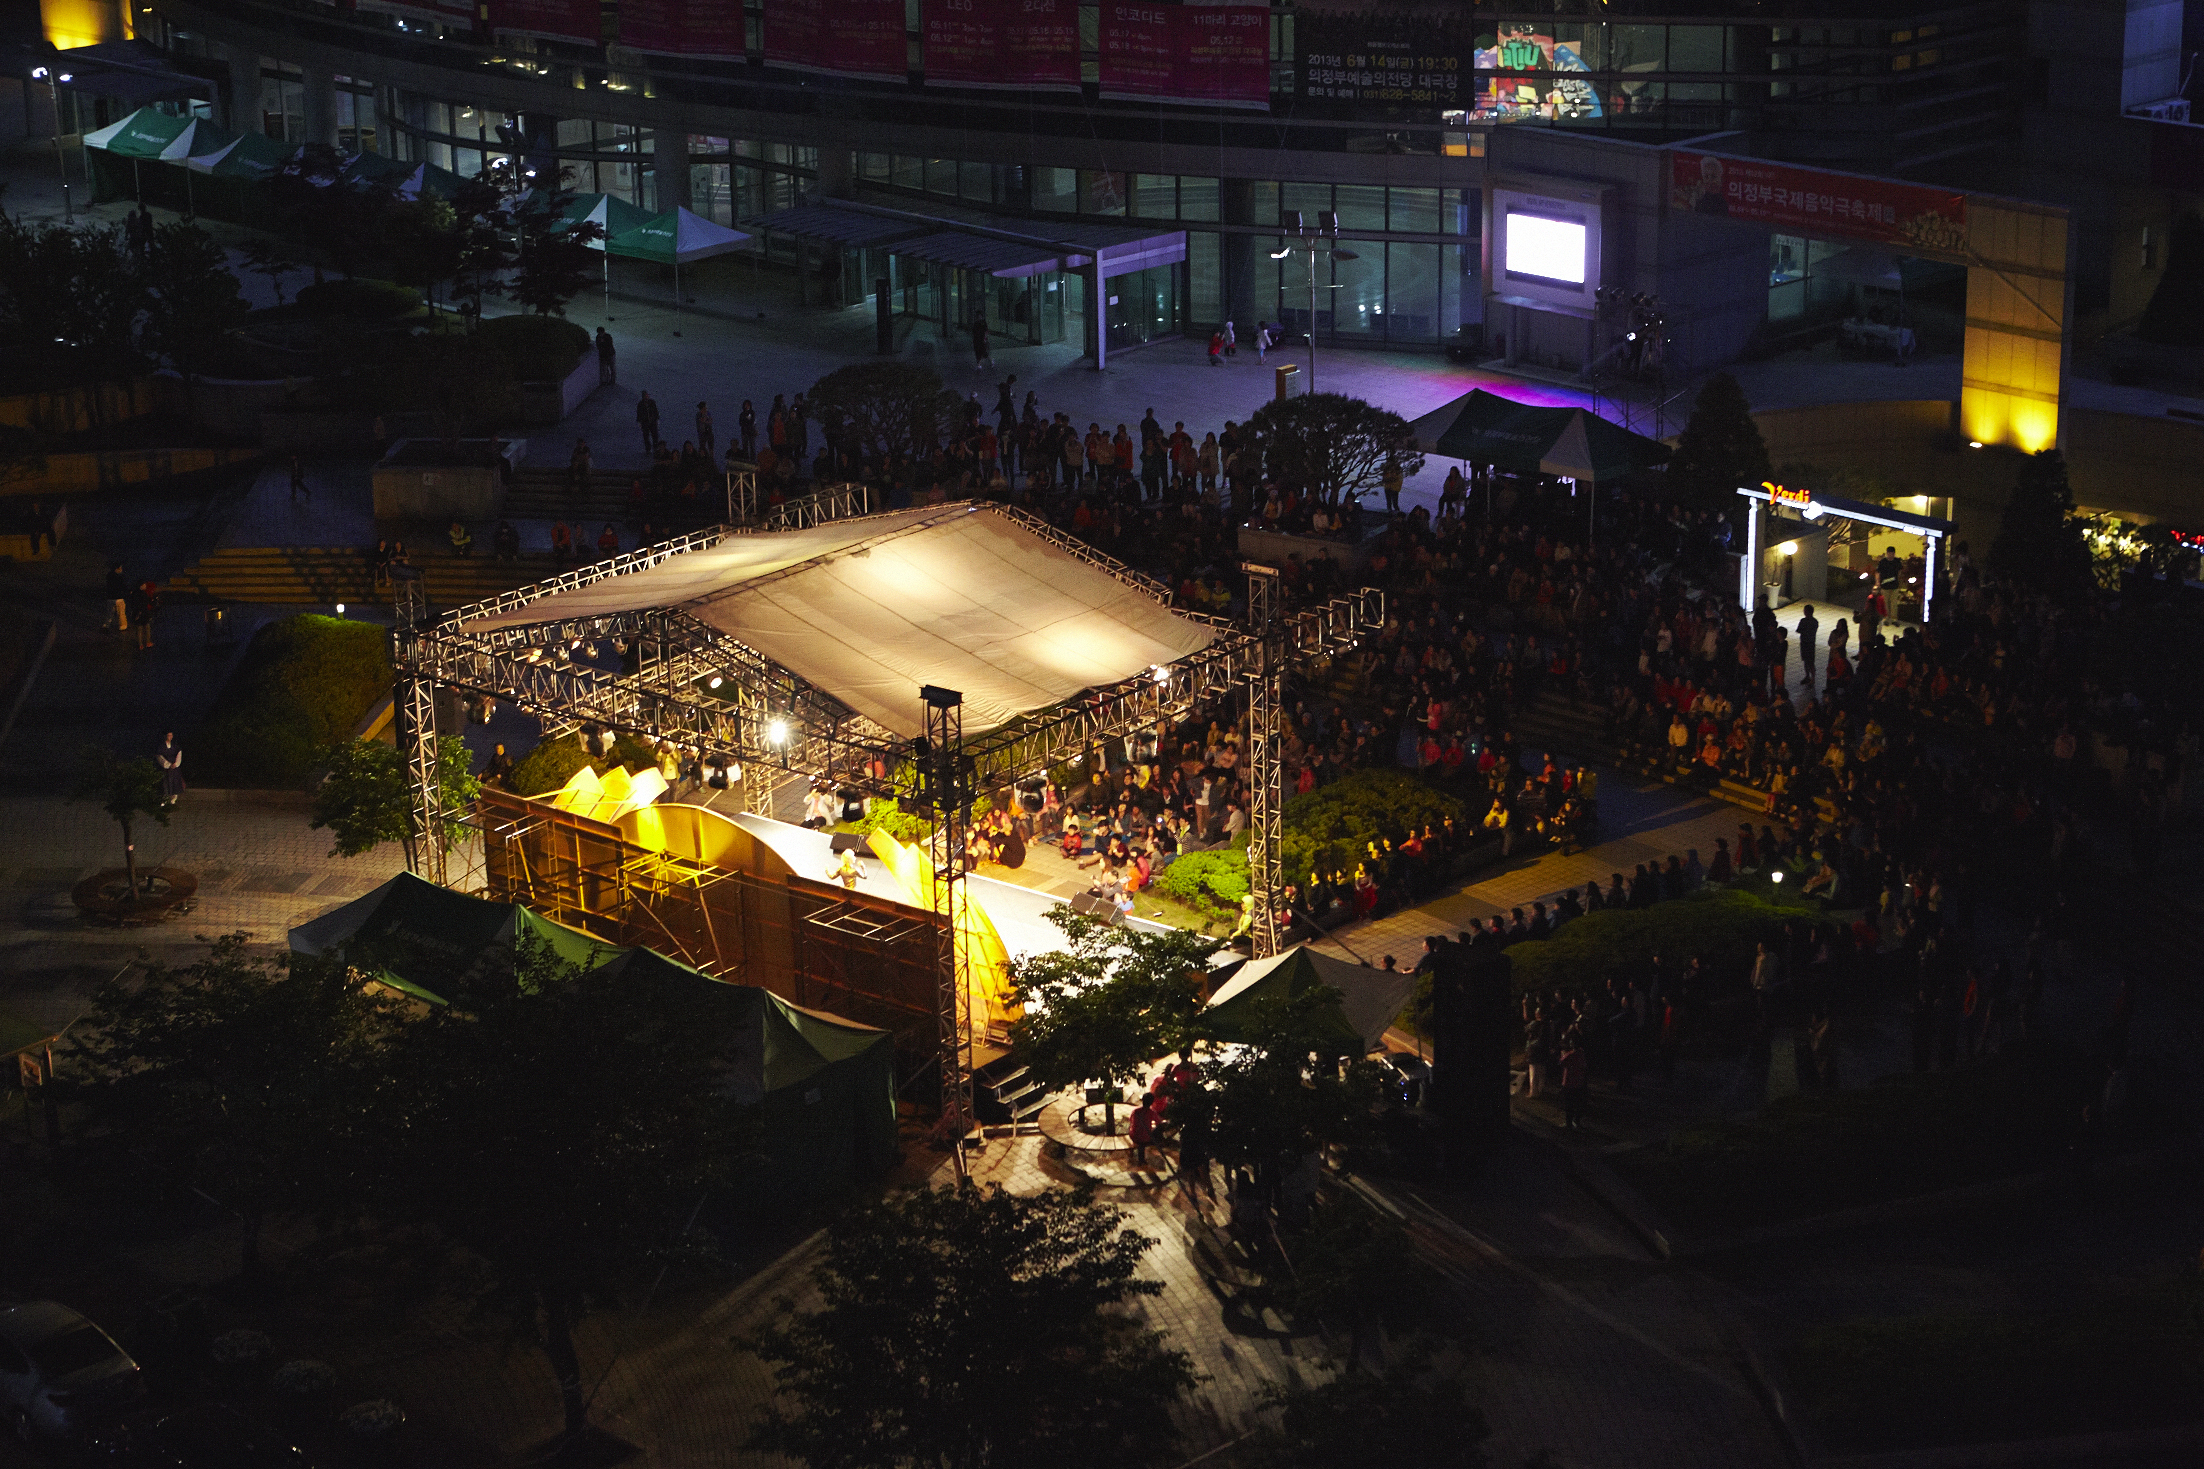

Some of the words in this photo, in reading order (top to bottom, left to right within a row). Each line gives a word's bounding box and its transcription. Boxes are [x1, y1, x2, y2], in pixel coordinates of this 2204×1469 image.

[946, 0, 973, 12] LEO
[930, 20, 952, 31] 05.11
[1193, 14, 1227, 26] 11마리
[1230, 15, 1263, 28] 고양이
[930, 33, 953, 43] 05.12
[1308, 53, 1342, 67] 2013년
[1346, 54, 1366, 68] 6월
[1370, 54, 1414, 70] 14일(금)
[1418, 56, 1458, 71] 19:30
[1308, 69, 1413, 88] 의정부예술의전당
[1418, 73, 1458, 90] 대극장
[1307, 86, 1324, 97] 문의
[1728, 180, 1884, 224] 의정부국제음악극축제
[1761, 481, 1810, 506] Verdi
